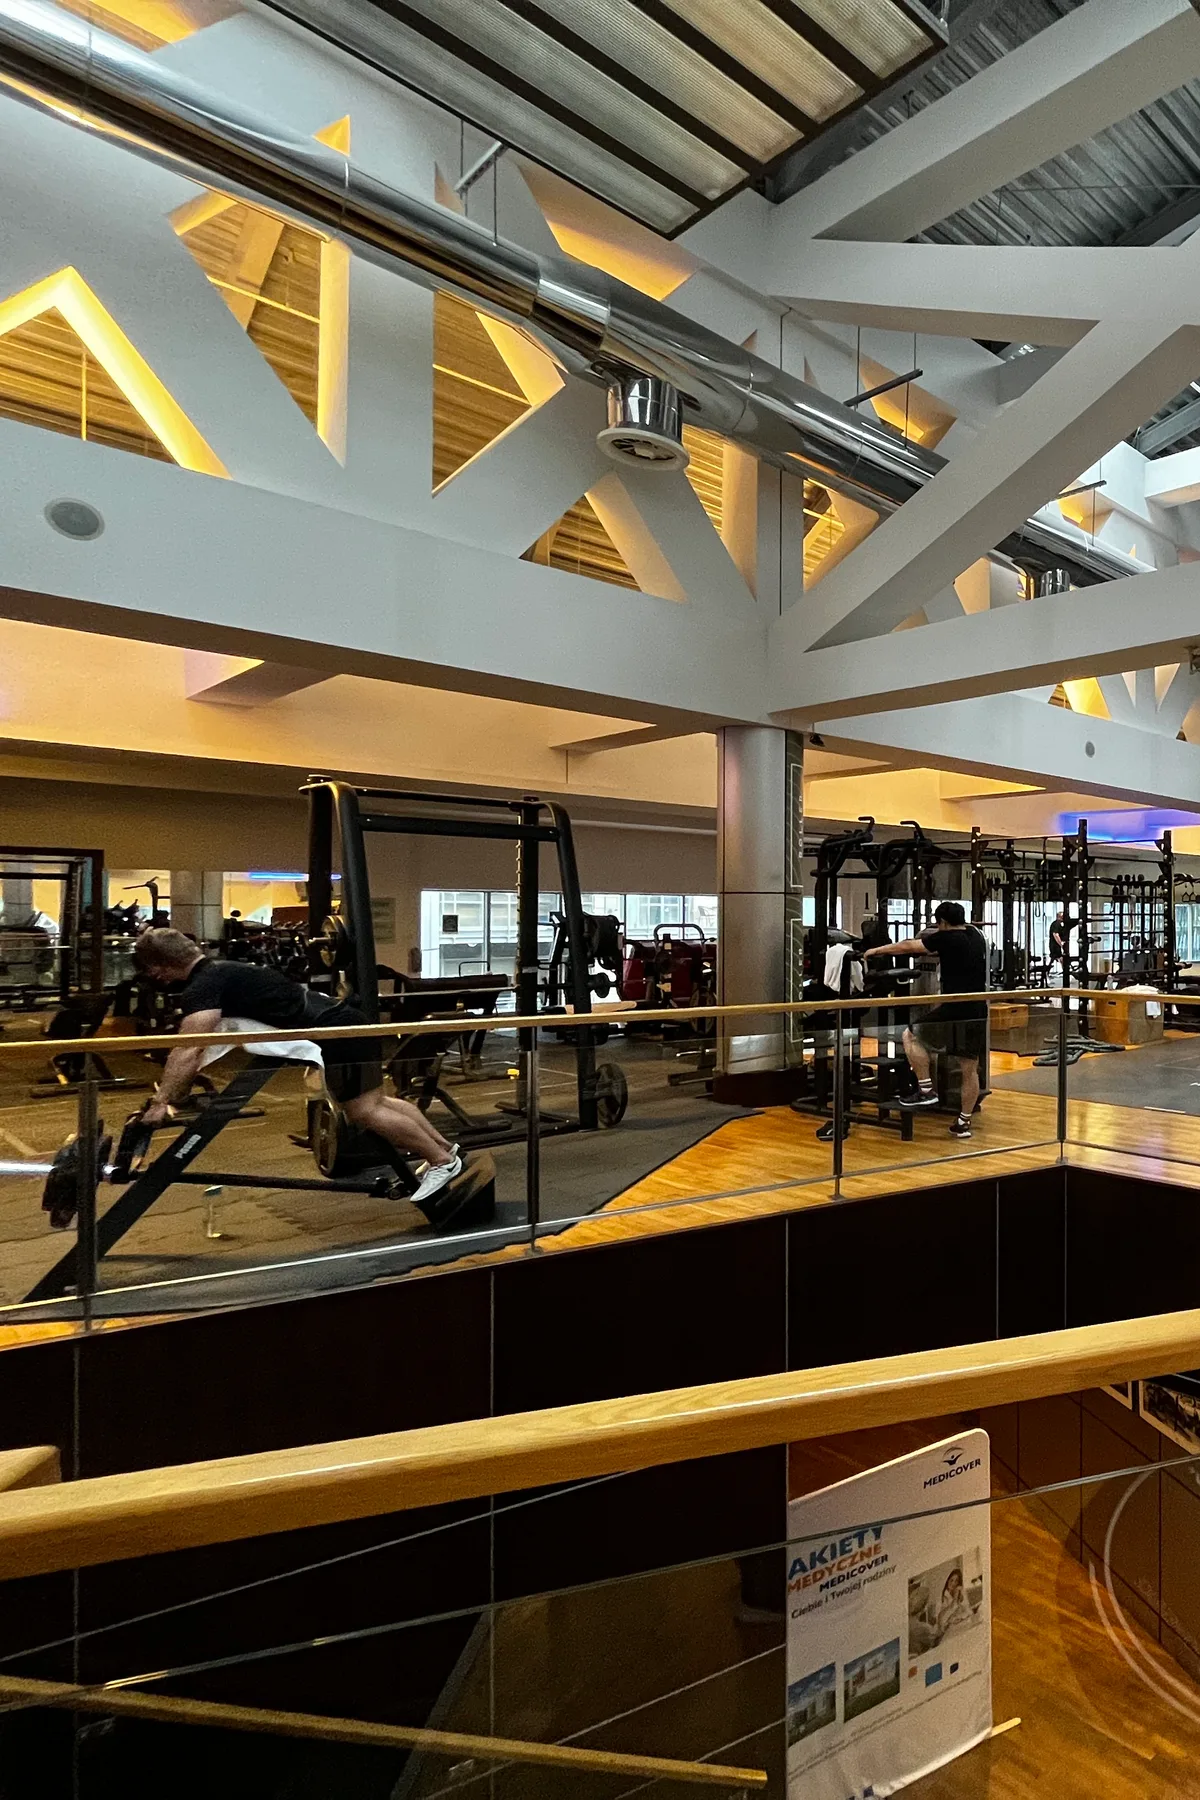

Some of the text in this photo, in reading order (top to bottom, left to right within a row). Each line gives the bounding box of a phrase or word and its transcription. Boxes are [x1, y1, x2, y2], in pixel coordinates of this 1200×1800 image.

[923, 1458, 981, 1489] MEDICOVER
[787, 1543, 883, 1593] MEDYCZNE
[819, 1554, 889, 1593] MEDICOVER
[830, 1582, 862, 1600] Twojej
[862, 1565, 897, 1587] rodziny
